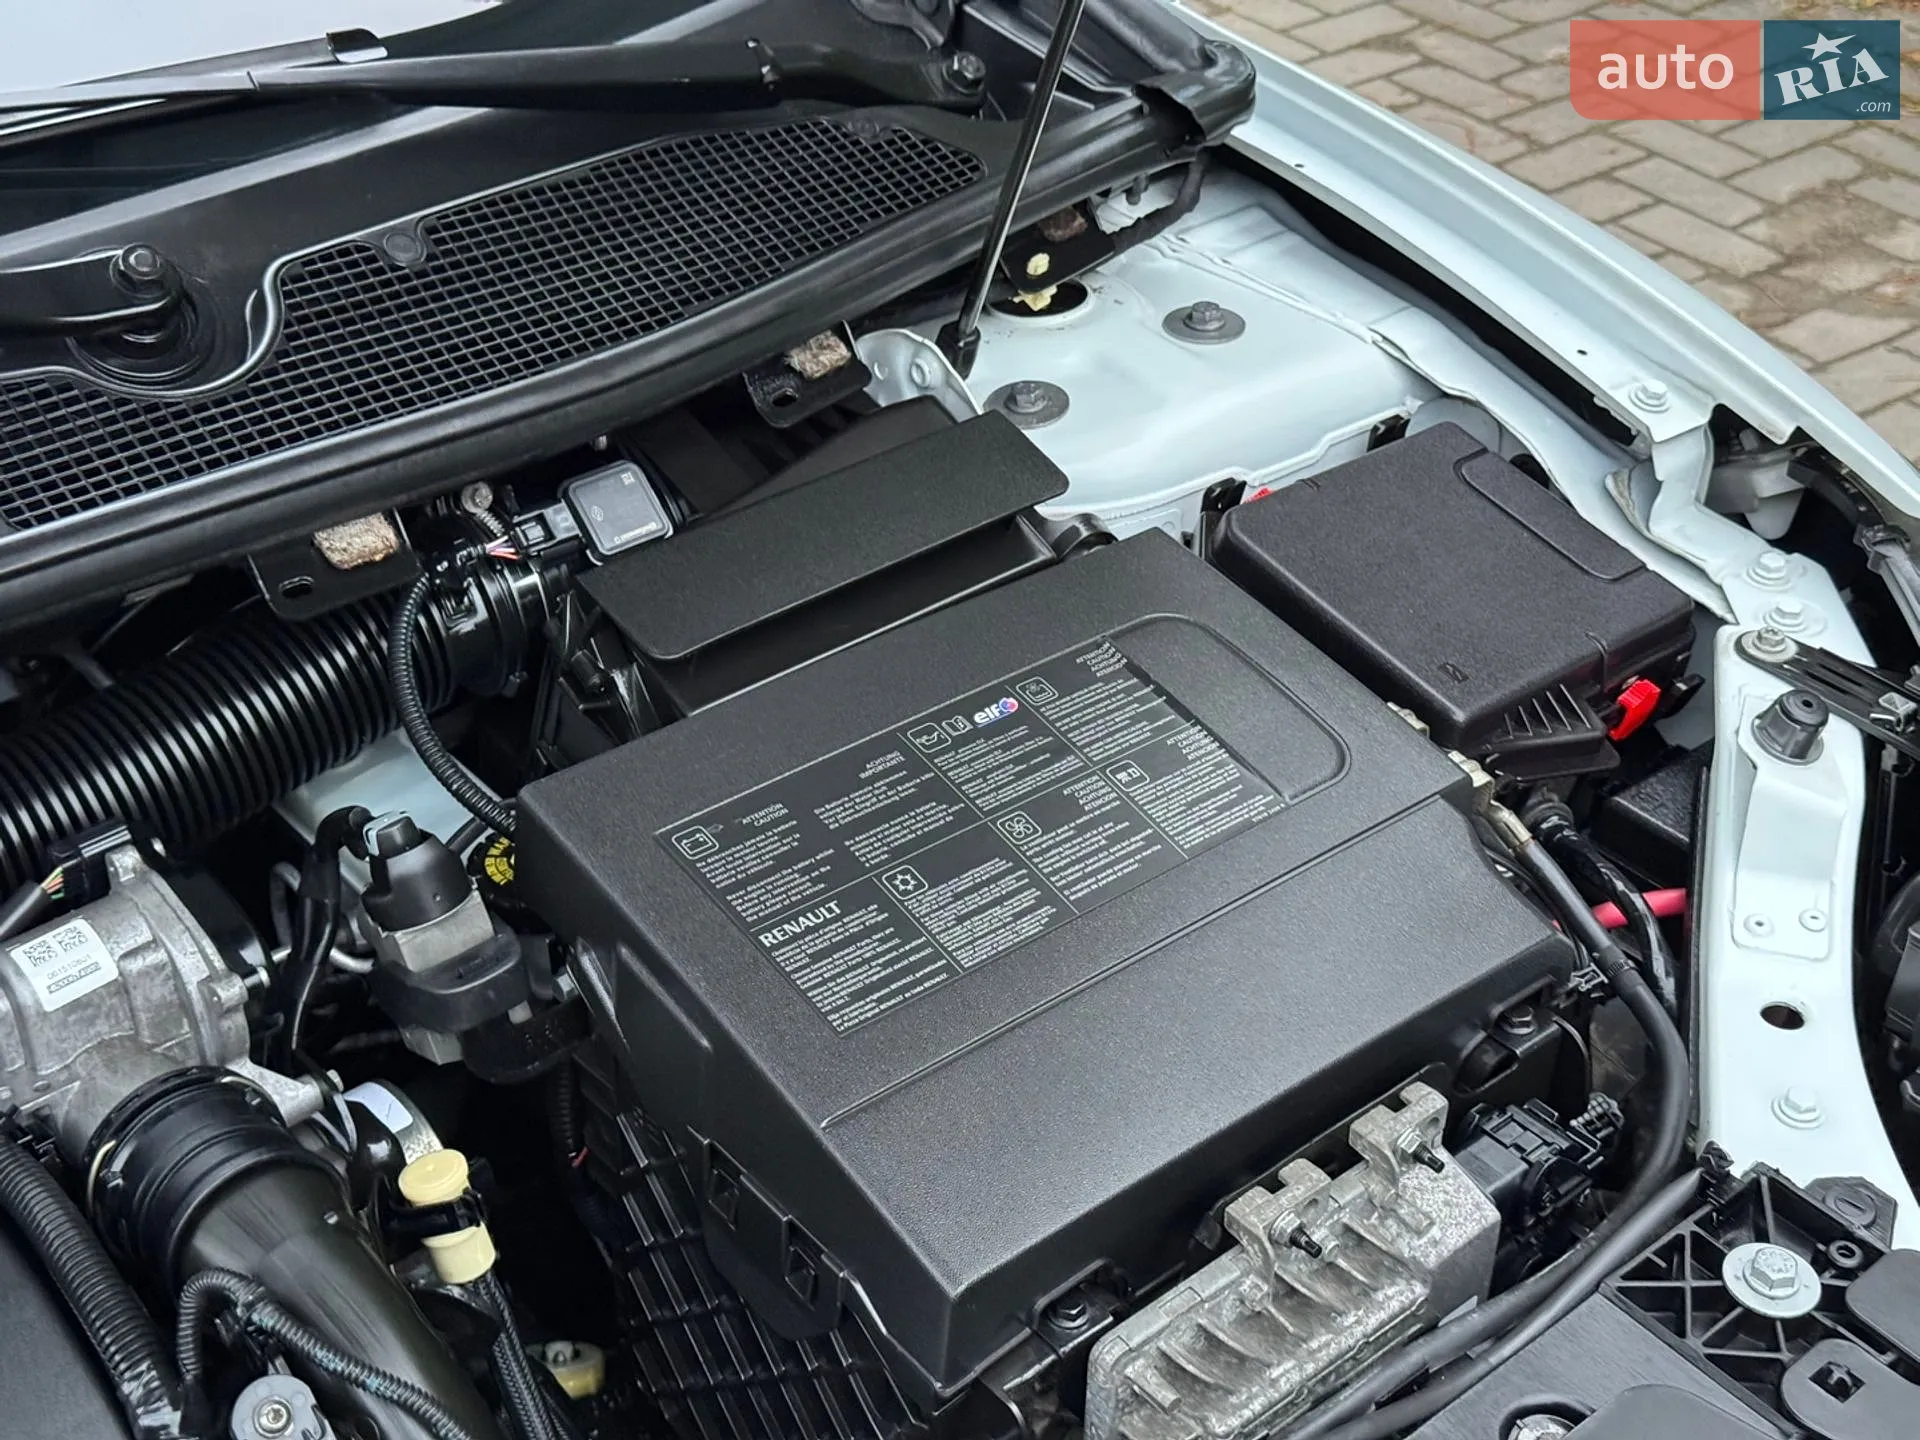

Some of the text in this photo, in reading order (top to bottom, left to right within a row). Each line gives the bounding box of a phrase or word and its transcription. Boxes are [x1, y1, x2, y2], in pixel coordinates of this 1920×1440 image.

[974, 704, 1004, 723] elf
[1166, 725, 1201, 745] ATTENTION
[1178, 731, 1207, 747] CAUTION
[1182, 736, 1213, 754] ACHTUNG
[866, 751, 900, 769] ACHTUNG
[1063, 775, 1100, 795] ATTENTION
[1074, 780, 1106, 798] CAUTION
[1079, 786, 1112, 805] ACHTUNG
[742, 803, 783, 824] ATTENTION
[754, 808, 789, 826] CAUTION
[759, 901, 840, 947] RENAULT
